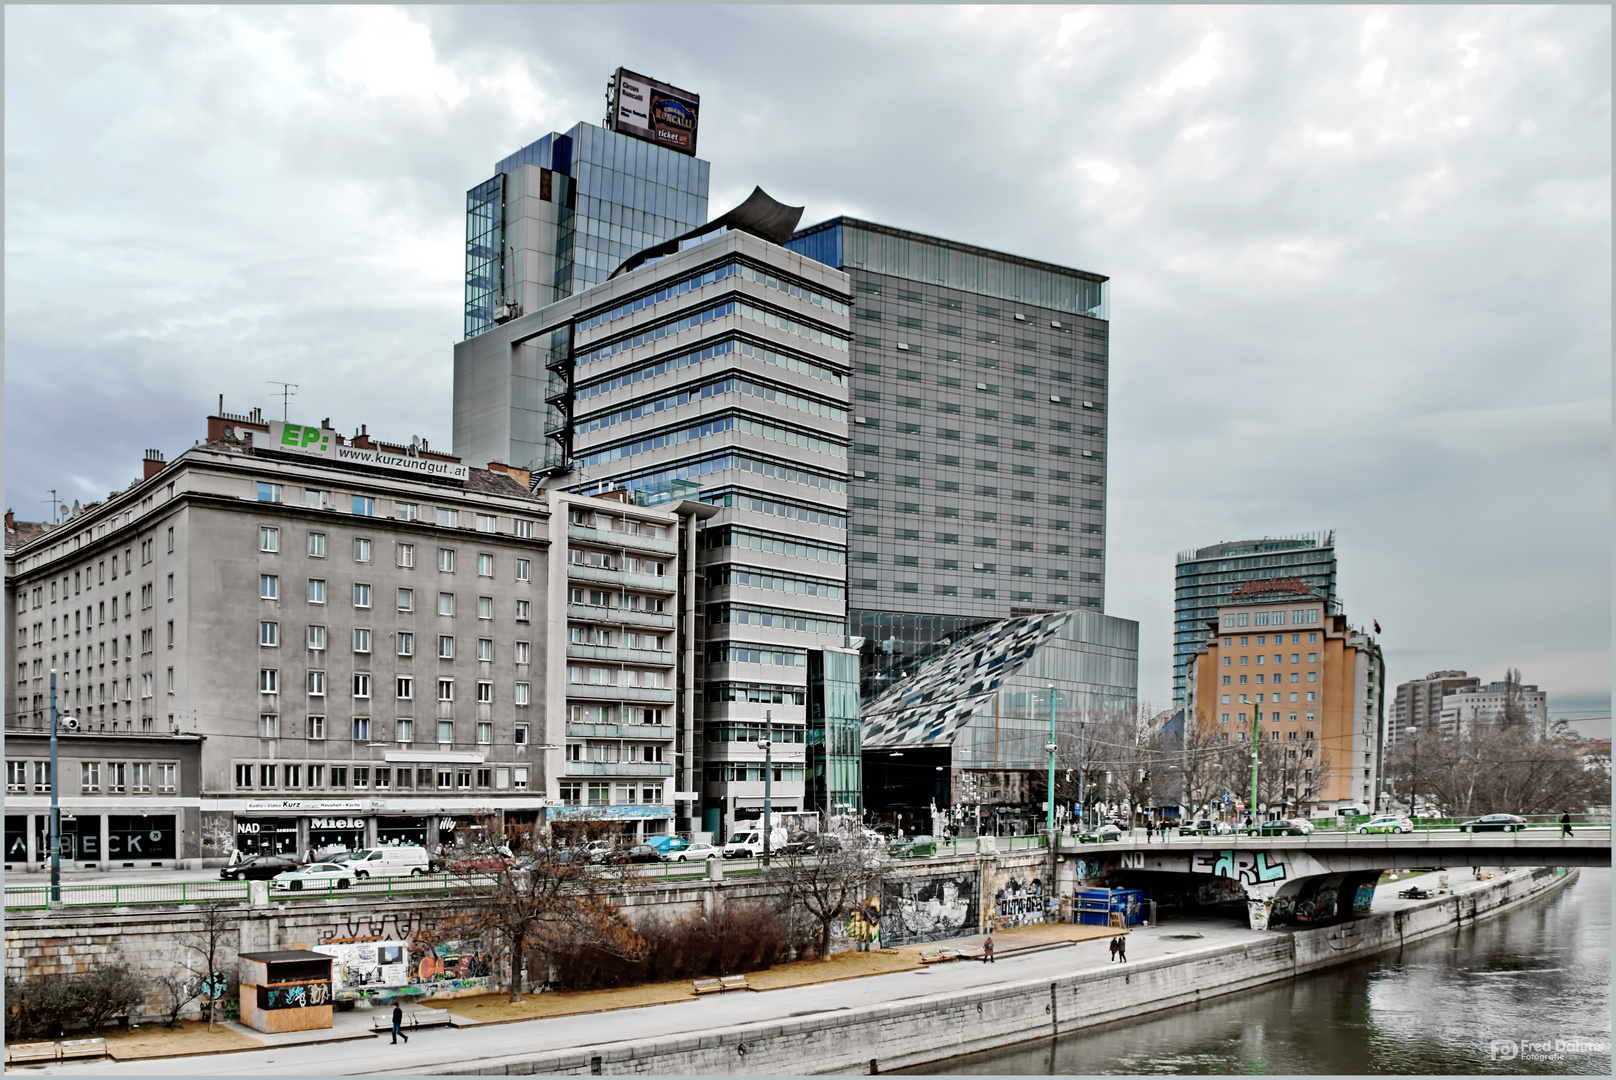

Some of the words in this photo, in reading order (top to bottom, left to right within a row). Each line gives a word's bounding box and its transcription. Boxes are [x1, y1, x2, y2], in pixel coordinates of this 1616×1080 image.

[621, 89, 643, 101] Roncalli
[622, 82, 639, 93] Circus
[655, 108, 692, 129] RONCALLI
[280, 423, 329, 452] EP:
[339, 448, 467, 477] www.kurzundgut.at
[237, 822, 261, 834] NAD
[310, 817, 365, 829] Miele
[439, 816, 457, 833] illy
[1120, 851, 1145, 869] NO
